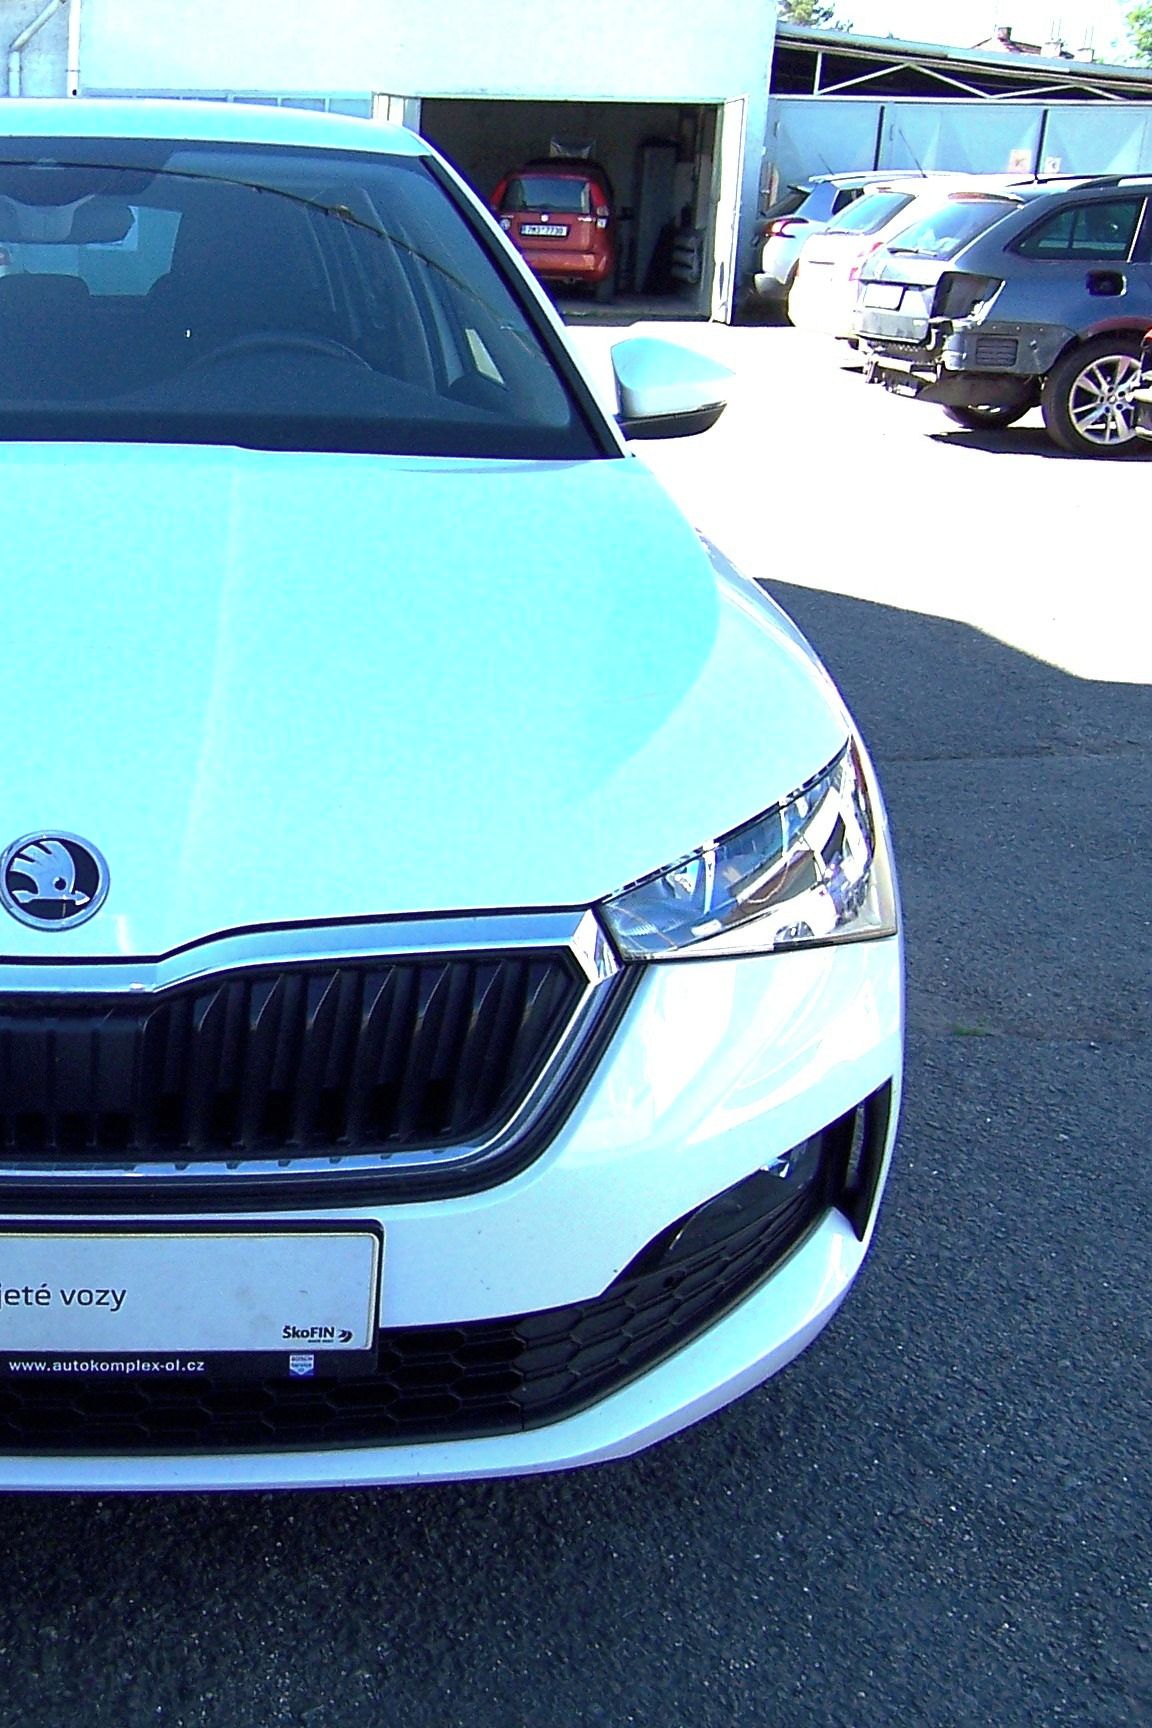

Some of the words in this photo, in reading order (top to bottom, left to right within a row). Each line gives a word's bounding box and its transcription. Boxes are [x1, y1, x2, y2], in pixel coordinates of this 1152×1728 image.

[60, 1288, 127, 1312] vozy
[282, 1324, 335, 1339] ŠkoFIN
[8, 1359, 205, 1374] www.autokomplex-ol.cz
